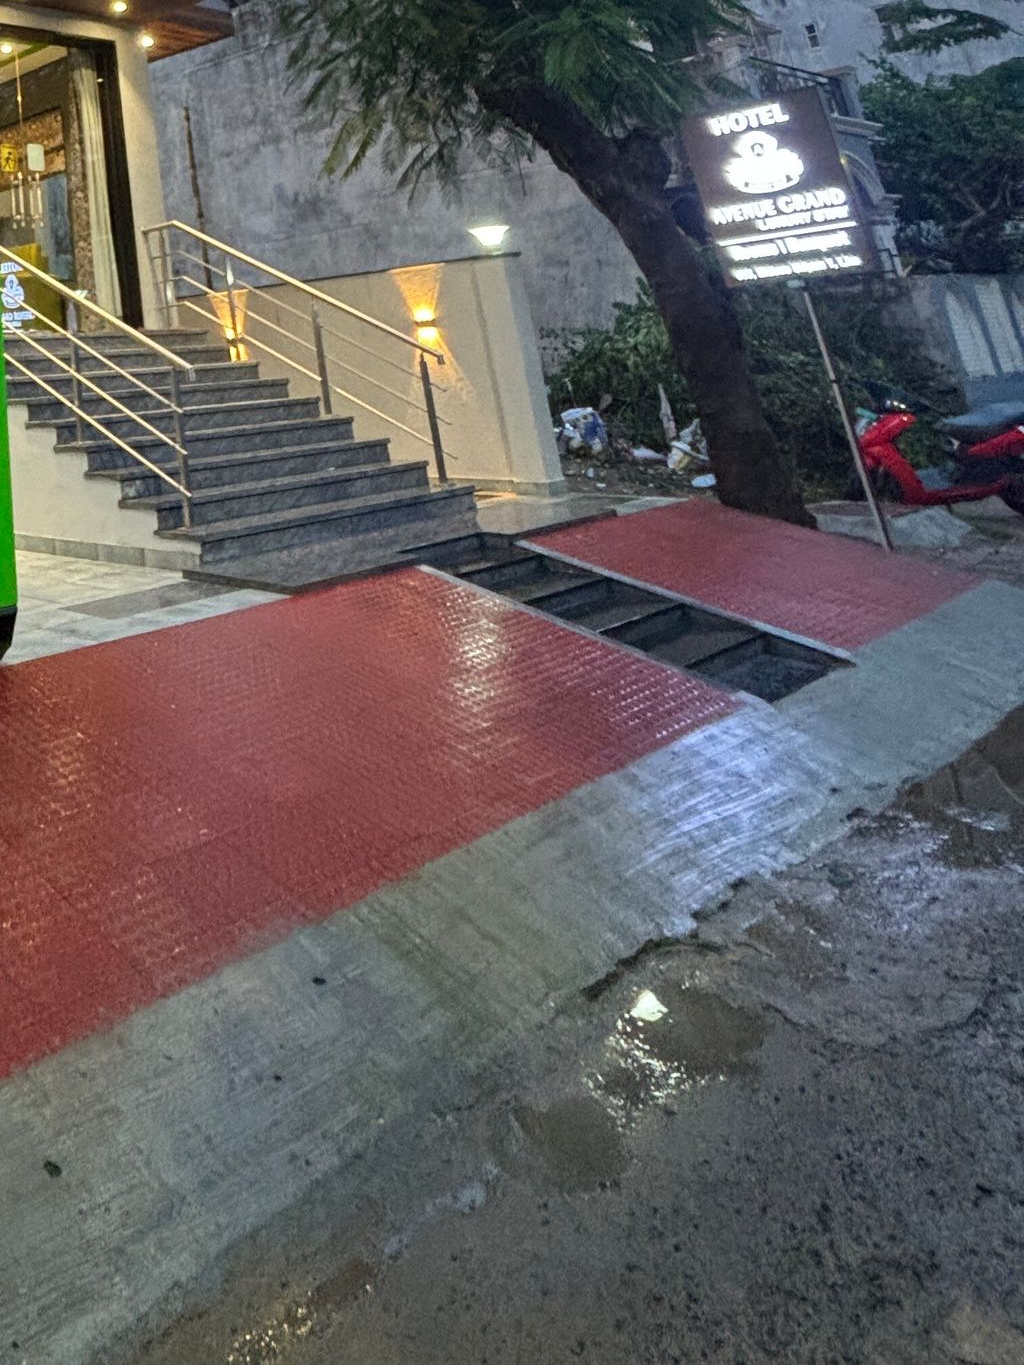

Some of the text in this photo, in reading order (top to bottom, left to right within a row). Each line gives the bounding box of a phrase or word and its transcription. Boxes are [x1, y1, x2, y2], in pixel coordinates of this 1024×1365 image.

[707, 104, 790, 136] HOTEL
[711, 187, 846, 225] AVENUE GRAND
